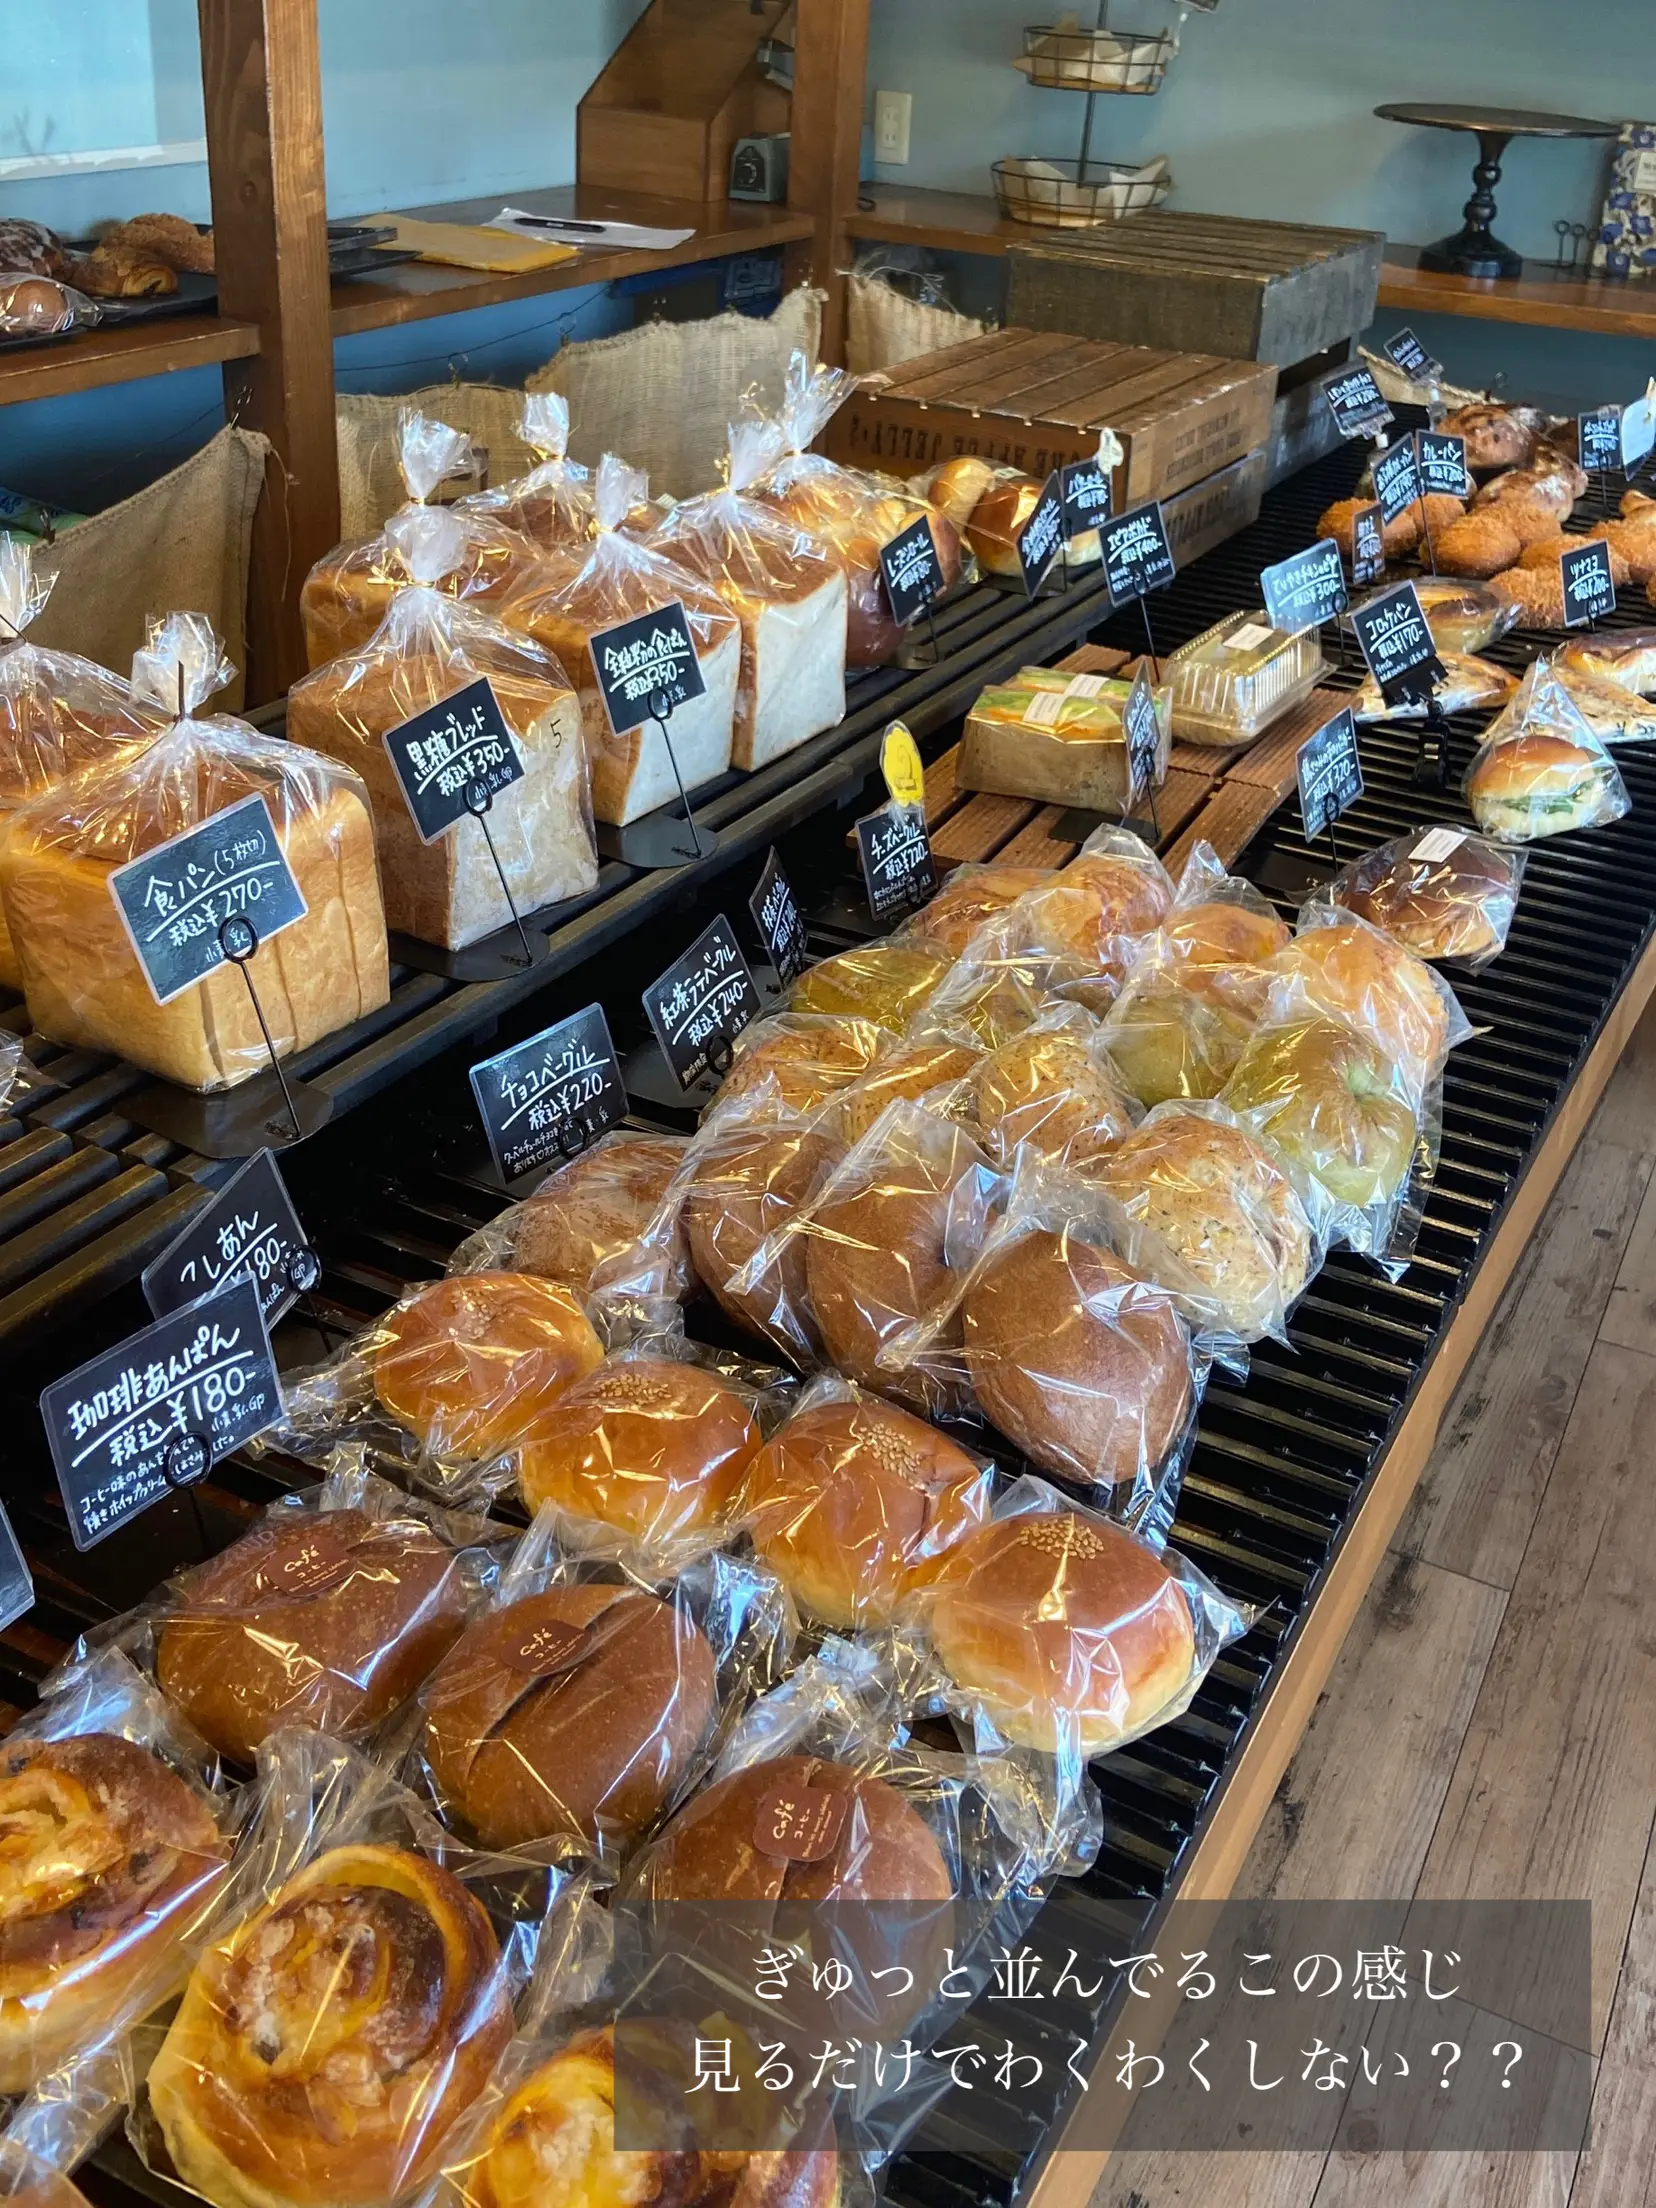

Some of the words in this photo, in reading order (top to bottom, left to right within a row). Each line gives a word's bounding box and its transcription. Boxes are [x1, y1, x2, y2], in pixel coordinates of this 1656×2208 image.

[1569, 554, 1599, 580] ツナマヨ
[1365, 602, 1413, 642] コロッケパン
[604, 628, 688, 679] 全粒粉の食ぱん
[624, 660, 686, 702] 税込¥350-
[405, 705, 487, 782] 黒糖ブレッド
[550, 718, 562, 749] 5
[436, 741, 510, 797] 税込¥350-
[870, 814, 922, 861] チーズベーグル
[884, 841, 929, 881] 税込¥220-
[168, 878, 274, 947] 税込¥270-
[660, 935, 737, 1031] 紅茶ラテベーグル
[687, 981, 749, 1047] 税込¥240-
[500, 1038, 596, 1109] チョコベーグル
[528, 1073, 612, 1131] 税込¥220-
[67, 1324, 241, 1441] 珈琲あんぱん
[108, 1366, 257, 1467] 税込¥180-
[284, 1544, 320, 1573] Café
[519, 1627, 553, 1657] Café
[772, 1799, 796, 1840] Café
